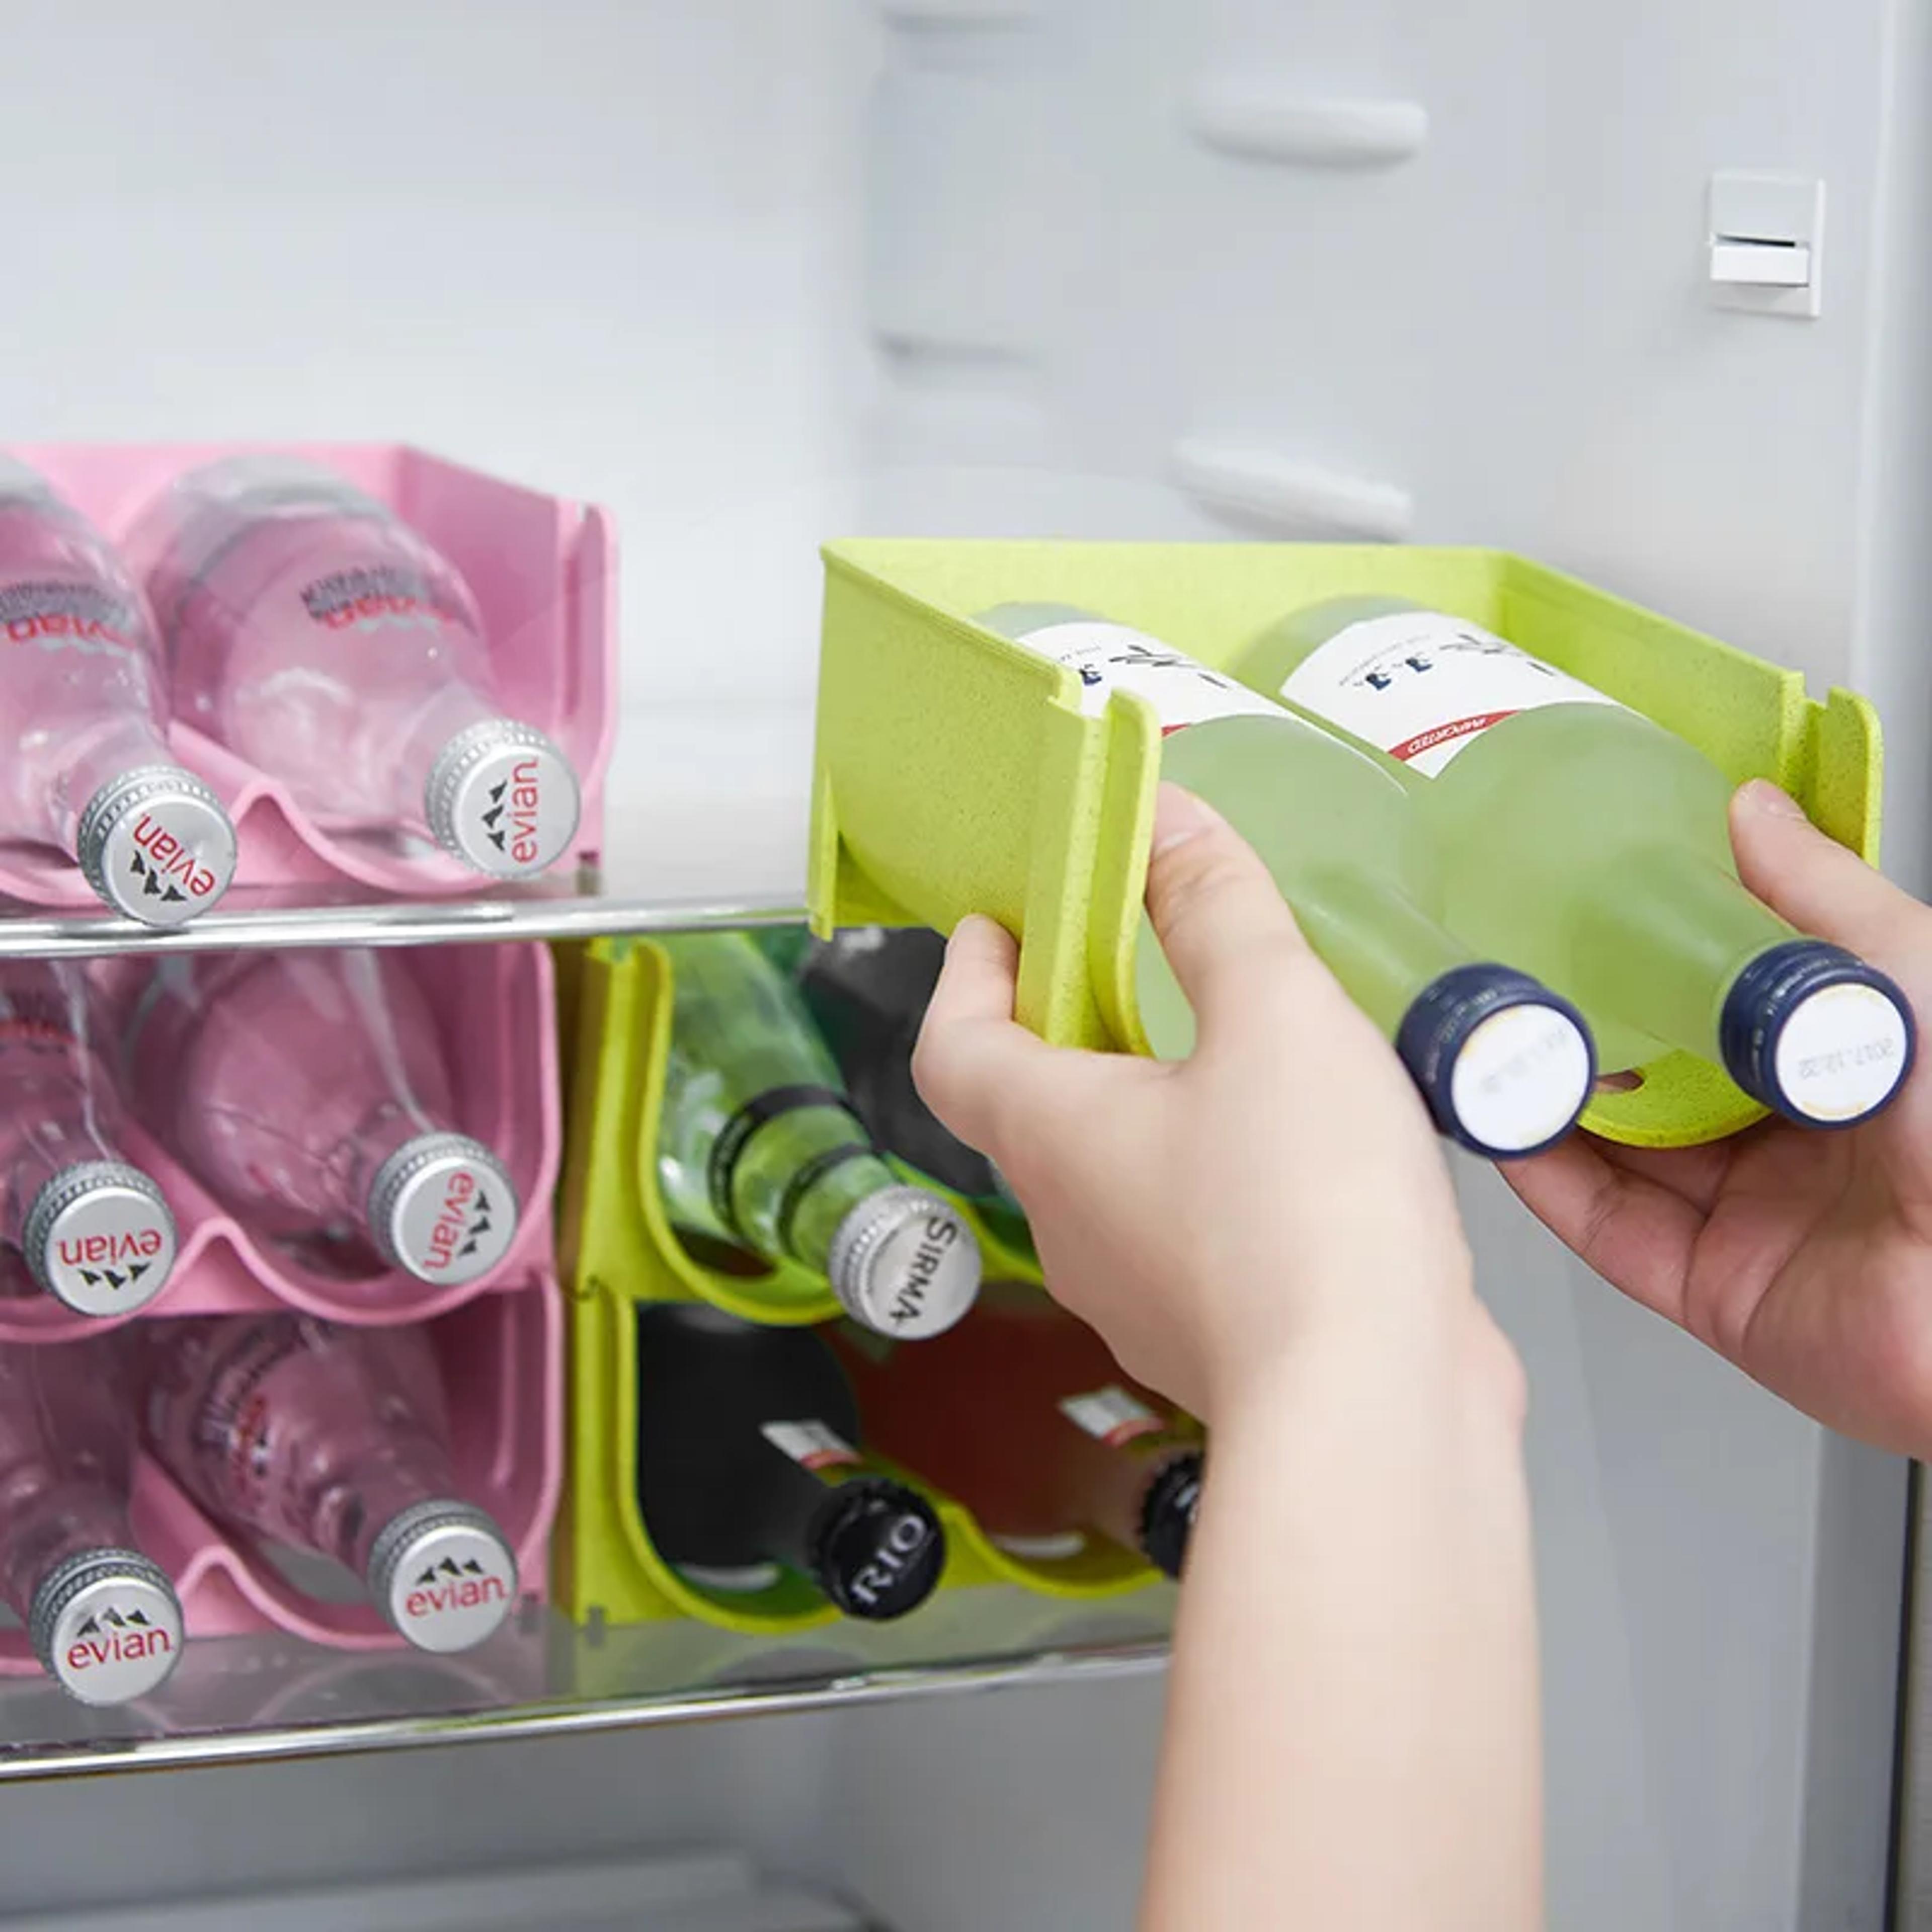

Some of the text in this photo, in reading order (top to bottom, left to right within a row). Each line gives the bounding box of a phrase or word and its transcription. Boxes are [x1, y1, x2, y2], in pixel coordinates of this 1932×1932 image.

[506, 760, 538, 864] evian
[133, 815, 216, 896] evian
[59, 1230, 163, 1266] evian
[425, 1171, 474, 1268] evian
[889, 1216, 959, 1325] SIRMA
[405, 1577, 503, 1615] evian
[851, 1515, 926, 1603] RIO
[66, 1628, 171, 1669] evian
